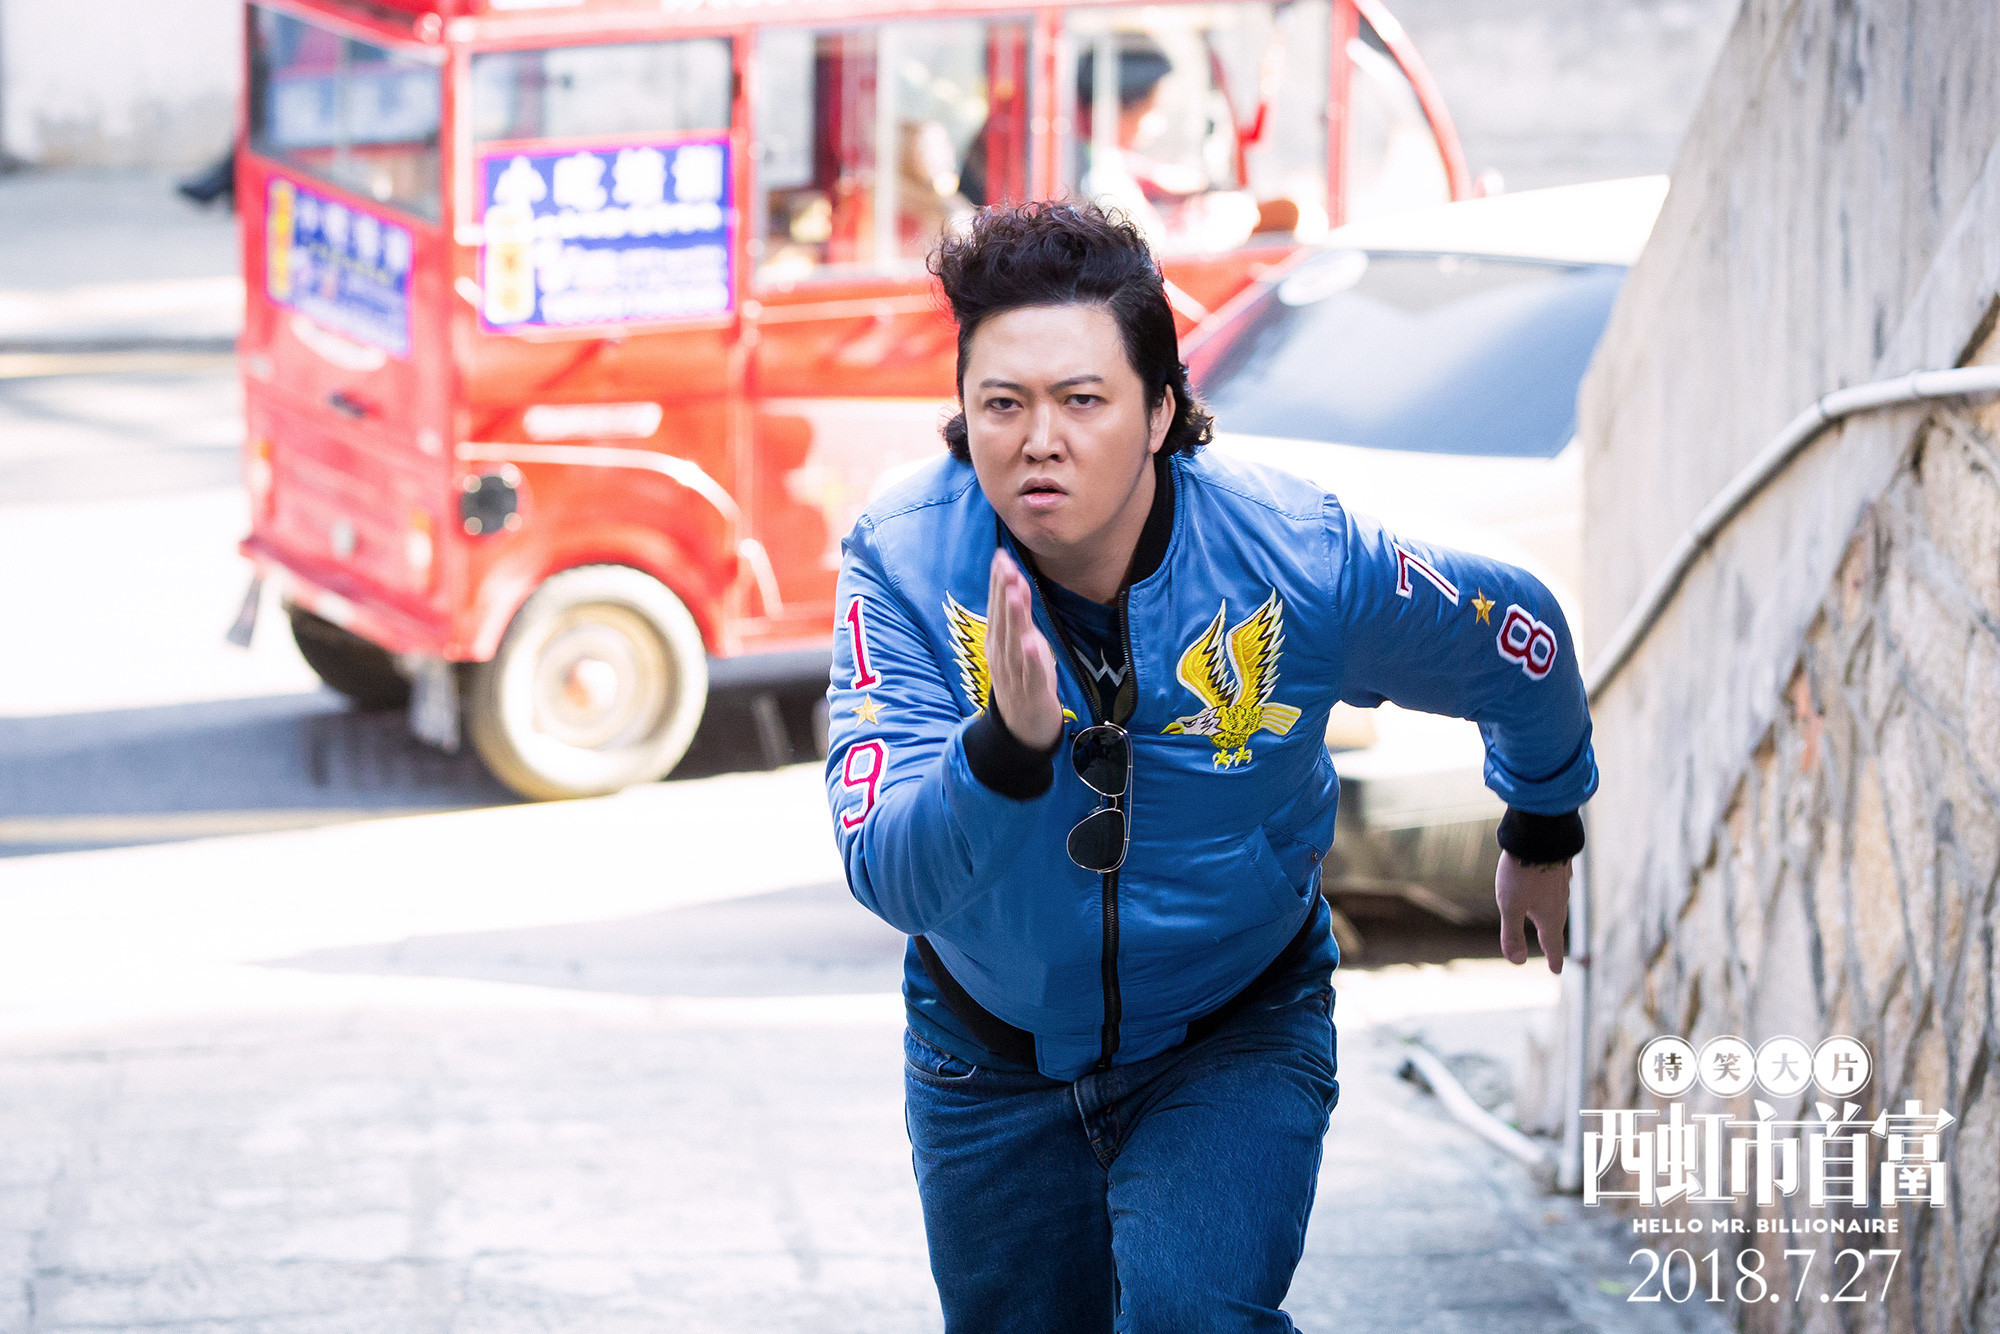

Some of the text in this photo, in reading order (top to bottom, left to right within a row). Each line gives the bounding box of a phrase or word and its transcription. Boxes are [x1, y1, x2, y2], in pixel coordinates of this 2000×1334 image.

[1393, 542, 1460, 607] 7
[844, 595, 882, 691] 1
[1496, 603, 1558, 681] 8
[840, 738, 889, 836] 9
